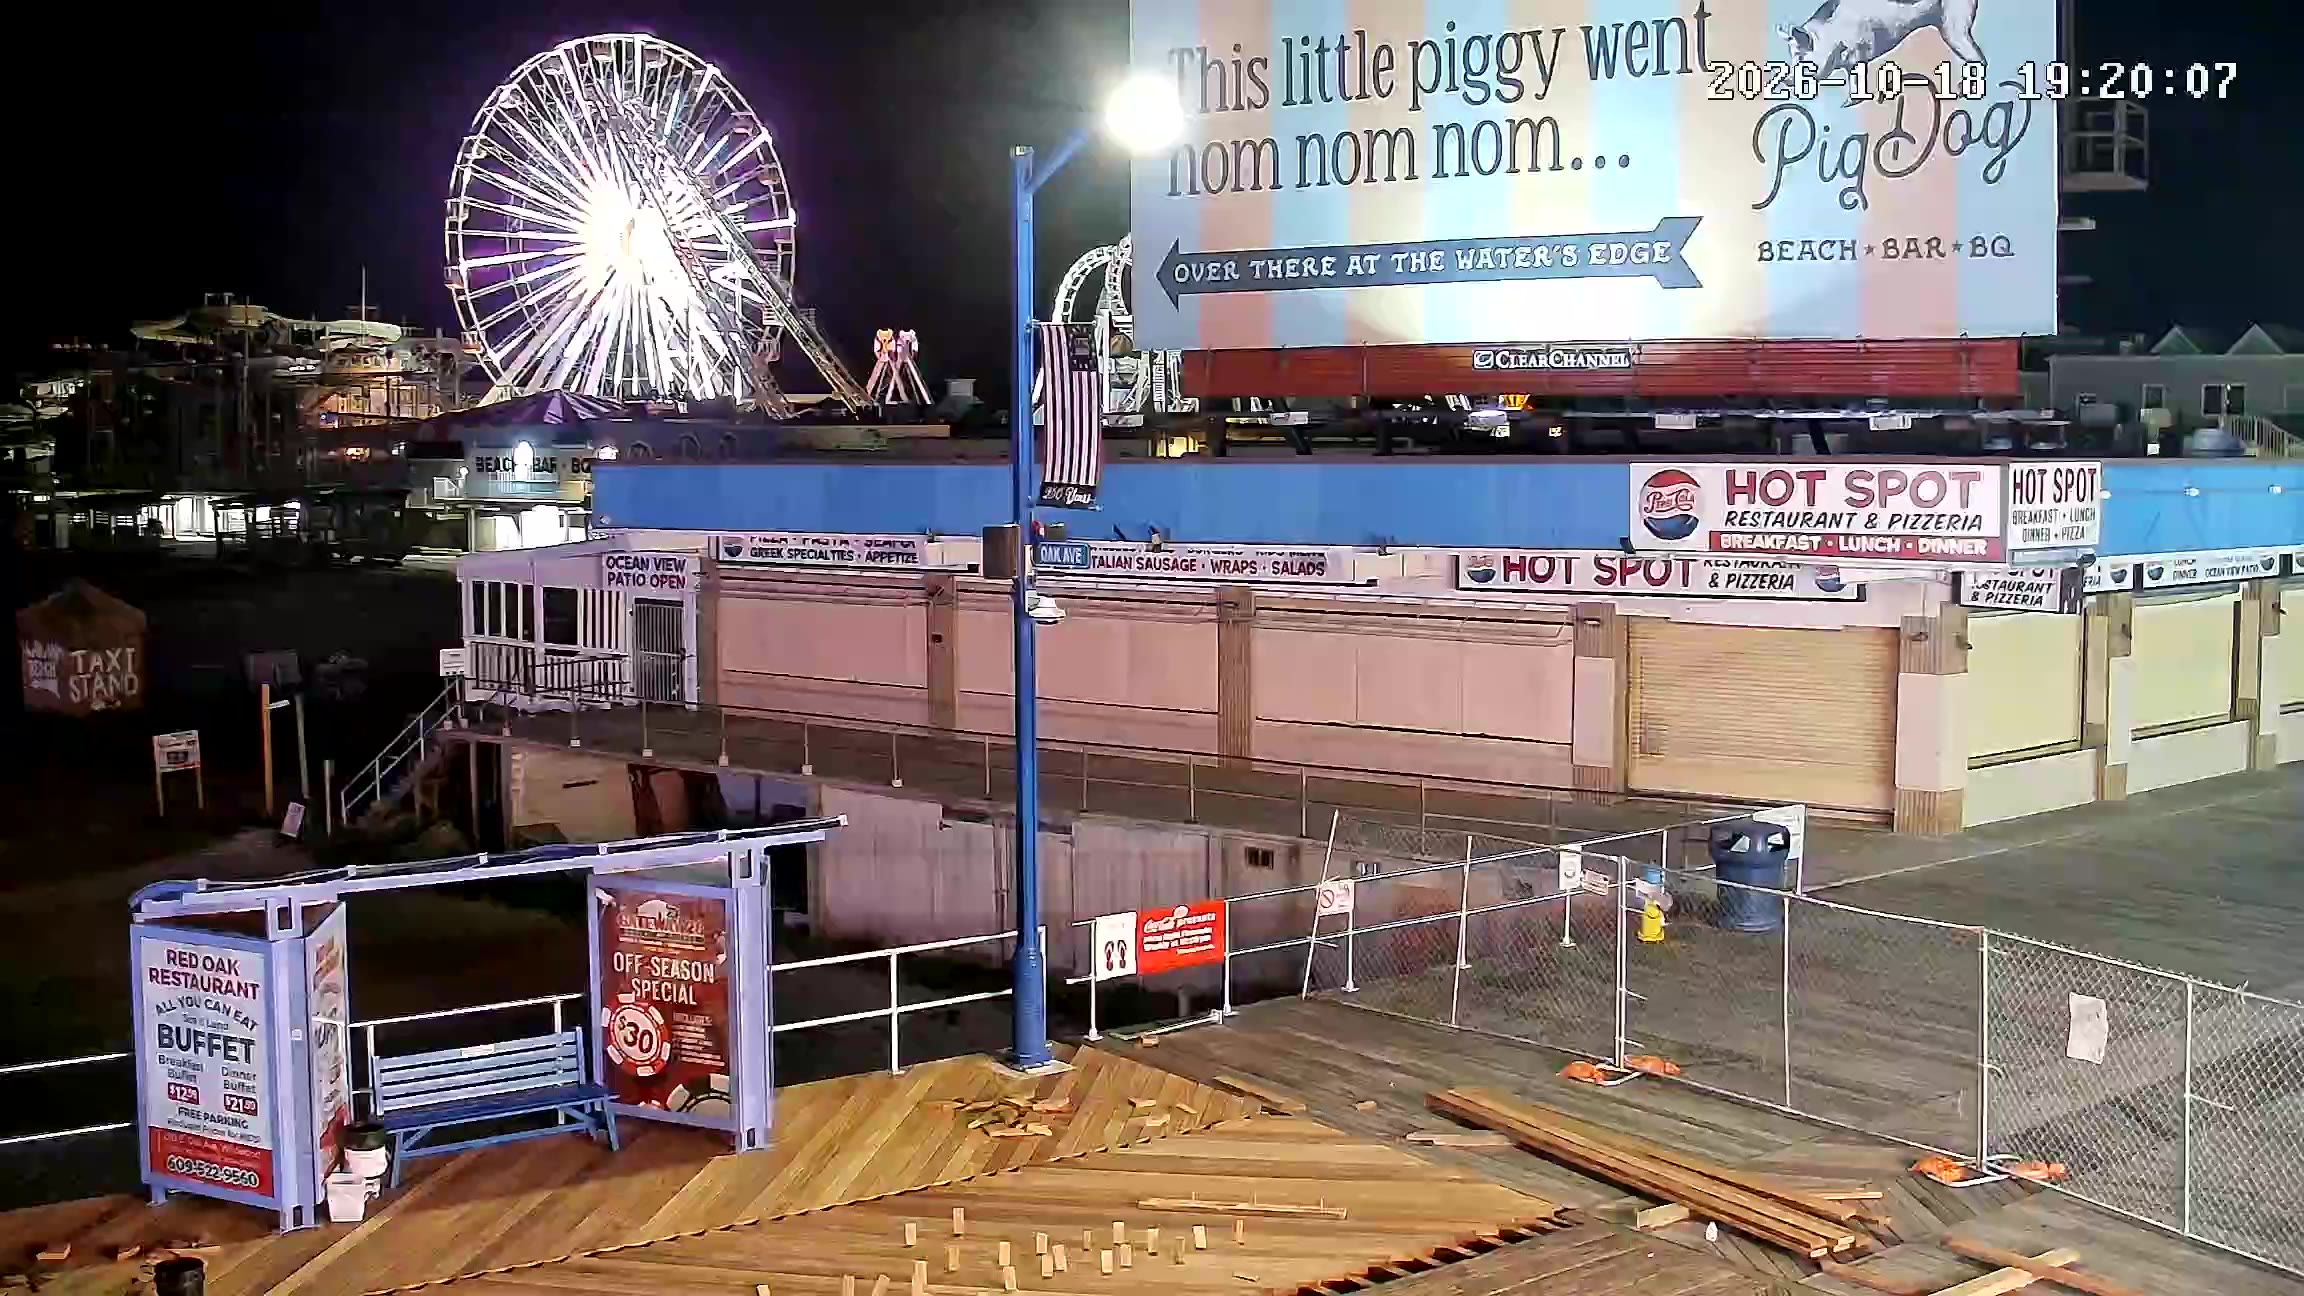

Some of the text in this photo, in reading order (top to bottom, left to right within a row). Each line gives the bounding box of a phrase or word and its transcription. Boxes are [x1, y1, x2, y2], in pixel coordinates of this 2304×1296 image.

[1167, 0, 1713, 114] This little piggy went
[1168, 115, 1632, 197] nom nom nom...
[1174, 241, 1672, 284] OVER THERE AT THE WATER'S EDGE
[1757, 237, 2016, 262] BEACH BAR BQ
[1725, 469, 1981, 509] HOT SPOT
[2013, 468, 2096, 505] HOT SPOT
[1724, 510, 1983, 531] RESTAURANT & PIZZERIA
[2013, 507, 2096, 525] BREAKFAST LUNCH
[1720, 533, 1987, 557] BREAKFAST LUNCH DINNER
[2023, 526, 2085, 543] DINNER PIZZA
[605, 555, 686, 573] OCEAN VIEW
[750, 547, 784, 559] GREEK
[787, 548, 854, 562] SPECIALTIES
[1040, 543, 1082, 565] OAK AVE
[1091, 556, 1326, 576] TALIAN SAUSAGE WRAPS SALADS
[607, 572, 686, 590] PATIO OPEN
[1503, 556, 1577, 585] HOT
[1594, 556, 1695, 589] SPOT
[1708, 572, 1795, 591] & PIZZERIA
[1985, 592, 2044, 607] PIZZERIA
[70, 648, 136, 675] TAXI
[69, 675, 139, 703] STAND
[166, 949, 240, 977] RED OAK
[613, 951, 715, 984] OFF SEASON
[149, 967, 260, 1000] RESTAURANT
[631, 977, 698, 1005] SPECIAL
[155, 996, 260, 1031] ALL YOU CAN EAT
[158, 1024, 256, 1065] BUFFET
[619, 1015, 654, 1054] $30
[223, 1080, 257, 1094] Buffet
[178, 1107, 249, 1130] FREE PARKING
